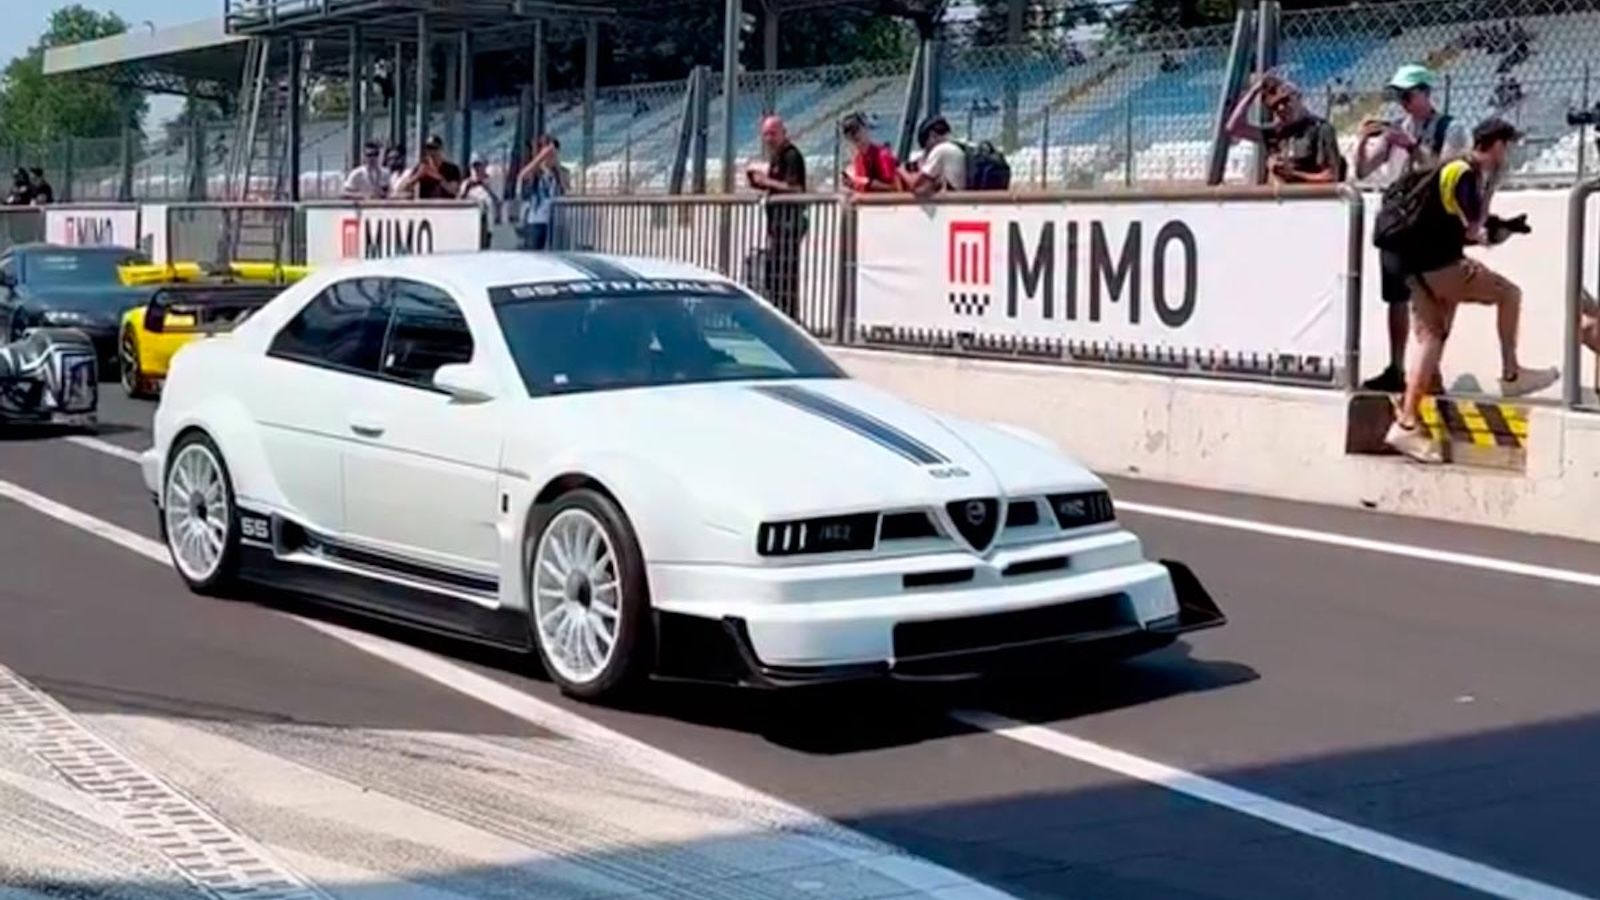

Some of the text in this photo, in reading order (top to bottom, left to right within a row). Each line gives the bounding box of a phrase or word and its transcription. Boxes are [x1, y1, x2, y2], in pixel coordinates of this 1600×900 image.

[365, 217, 433, 259] MIMO
[1006, 219, 1198, 328] MIMO
[240, 516, 269, 539] SS
